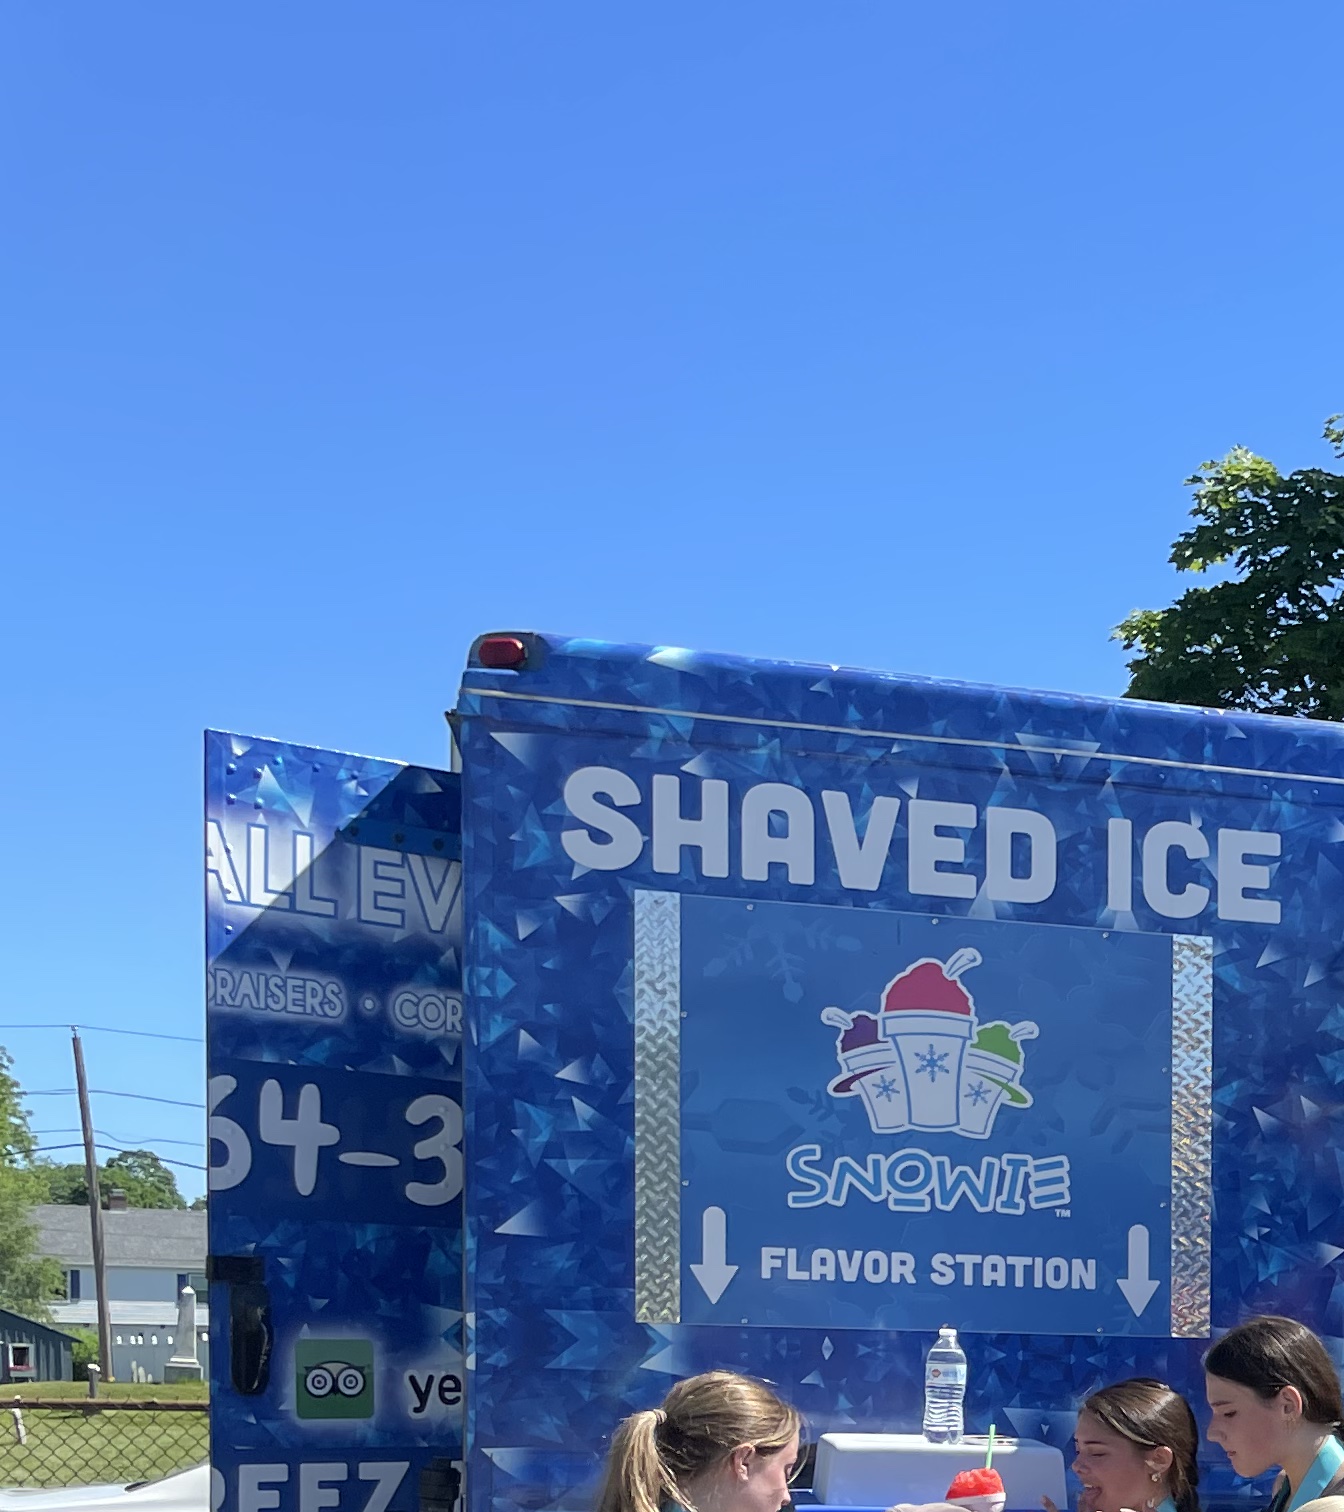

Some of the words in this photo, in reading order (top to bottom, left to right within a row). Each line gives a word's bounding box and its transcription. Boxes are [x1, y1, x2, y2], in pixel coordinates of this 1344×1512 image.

[561, 766, 1056, 903] SHAVED
[1107, 817, 1282, 924] ICE
[207, 968, 343, 1020] RAISERS
[394, 991, 462, 1033] COR
[786, 1144, 1071, 1216] SNOWIE
[761, 1247, 916, 1284] FLAVOR
[930, 1253, 1096, 1290] STATION
[408, 1373, 462, 1413] ye
